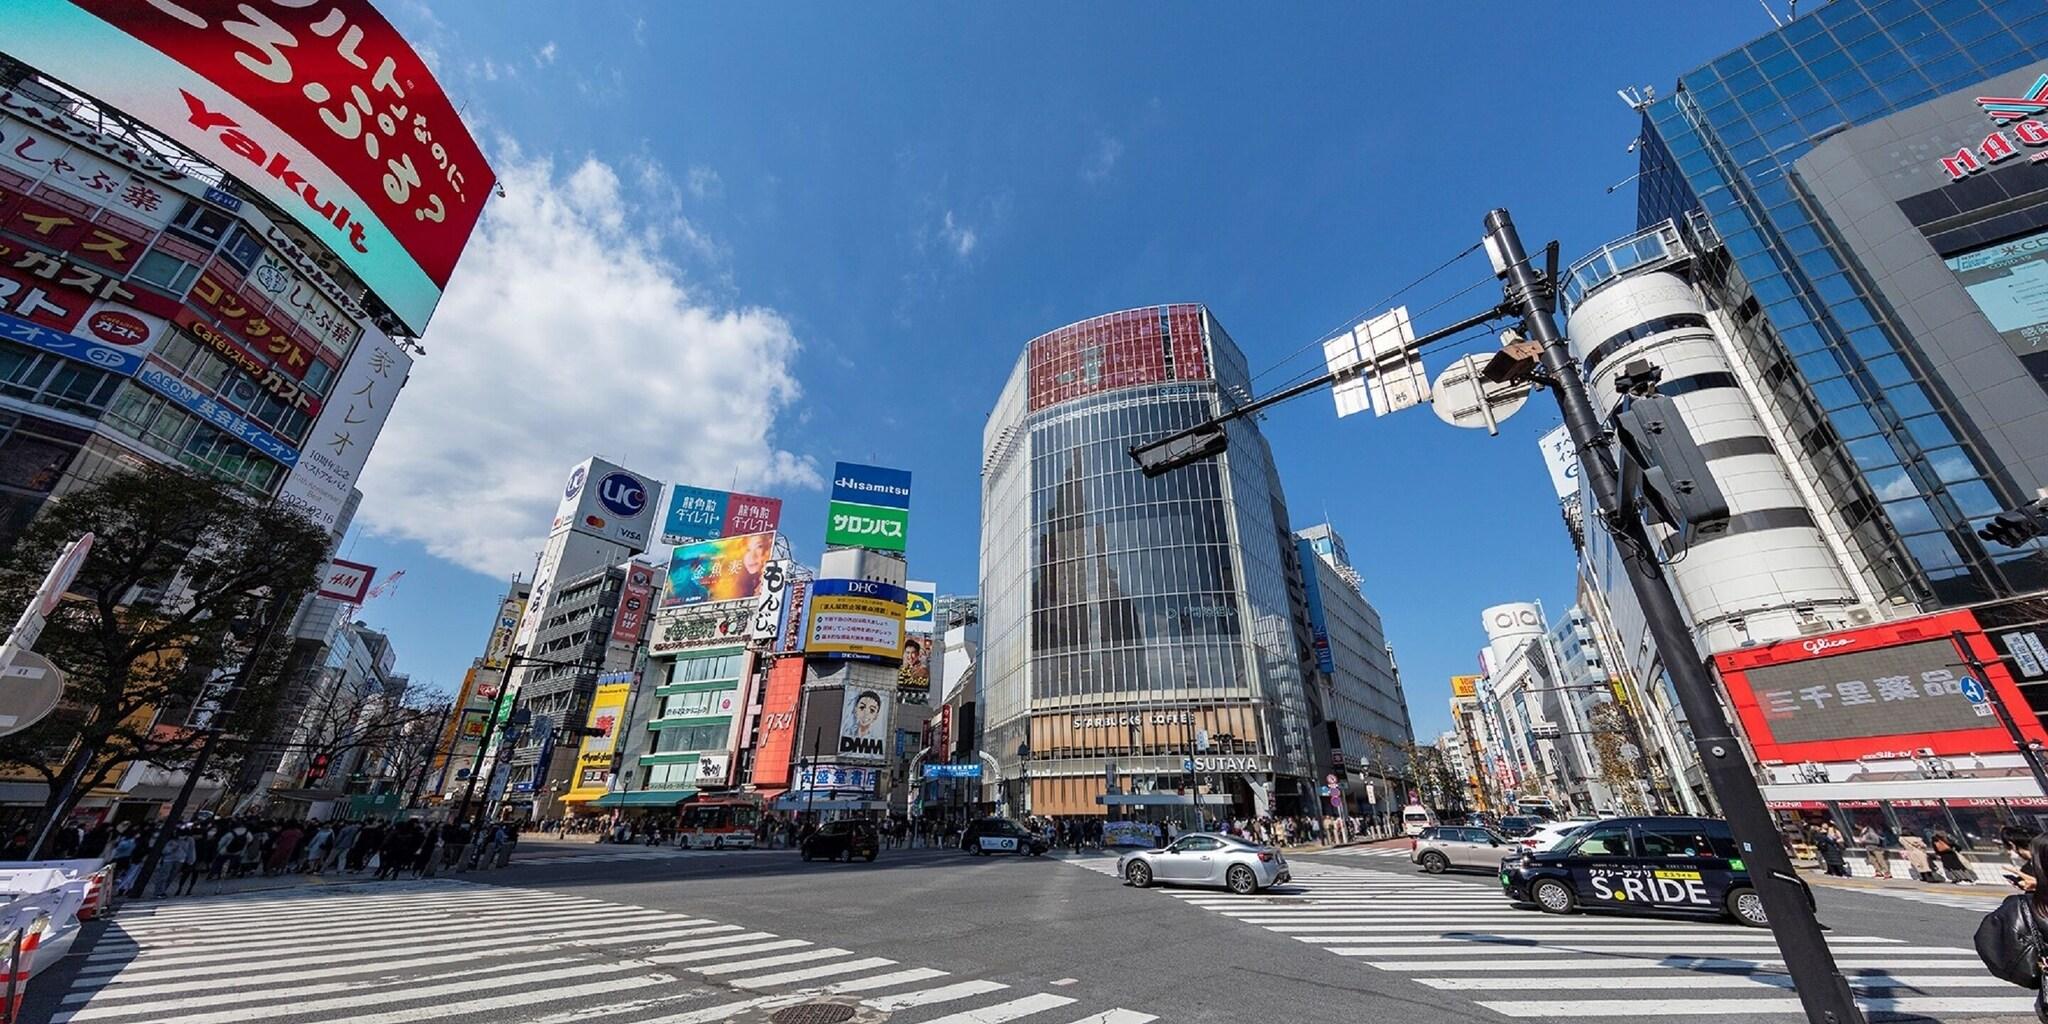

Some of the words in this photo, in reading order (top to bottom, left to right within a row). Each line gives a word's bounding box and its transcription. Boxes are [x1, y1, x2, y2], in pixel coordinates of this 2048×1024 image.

[178, 87, 368, 253] Yakult
[193, 274, 305, 368] コンタクト
[290, 285, 353, 346] しゃぶ葉
[91, 350, 122, 363] 6F
[260, 370, 311, 410] ガスト
[149, 371, 194, 402] AEON
[197, 398, 297, 461] 英会話イーオン
[835, 477, 909, 496] Hisamitsu
[620, 527, 641, 541] VISA
[833, 514, 902, 537] サロンパス
[754, 561, 785, 636] もんじゃ
[848, 582, 878, 594] DHC
[1803, 638, 1857, 654] Glico
[1766, 669, 1960, 713] 三千里薬品
[1073, 715, 1142, 730] STARBUCKS
[1149, 713, 1196, 727] COFFEE
[841, 736, 884, 755] DMM
[1194, 757, 1258, 772] SUTAYA
[1589, 868, 1652, 879] タクシーアプリ
[1591, 876, 1712, 905] S.RIDE
